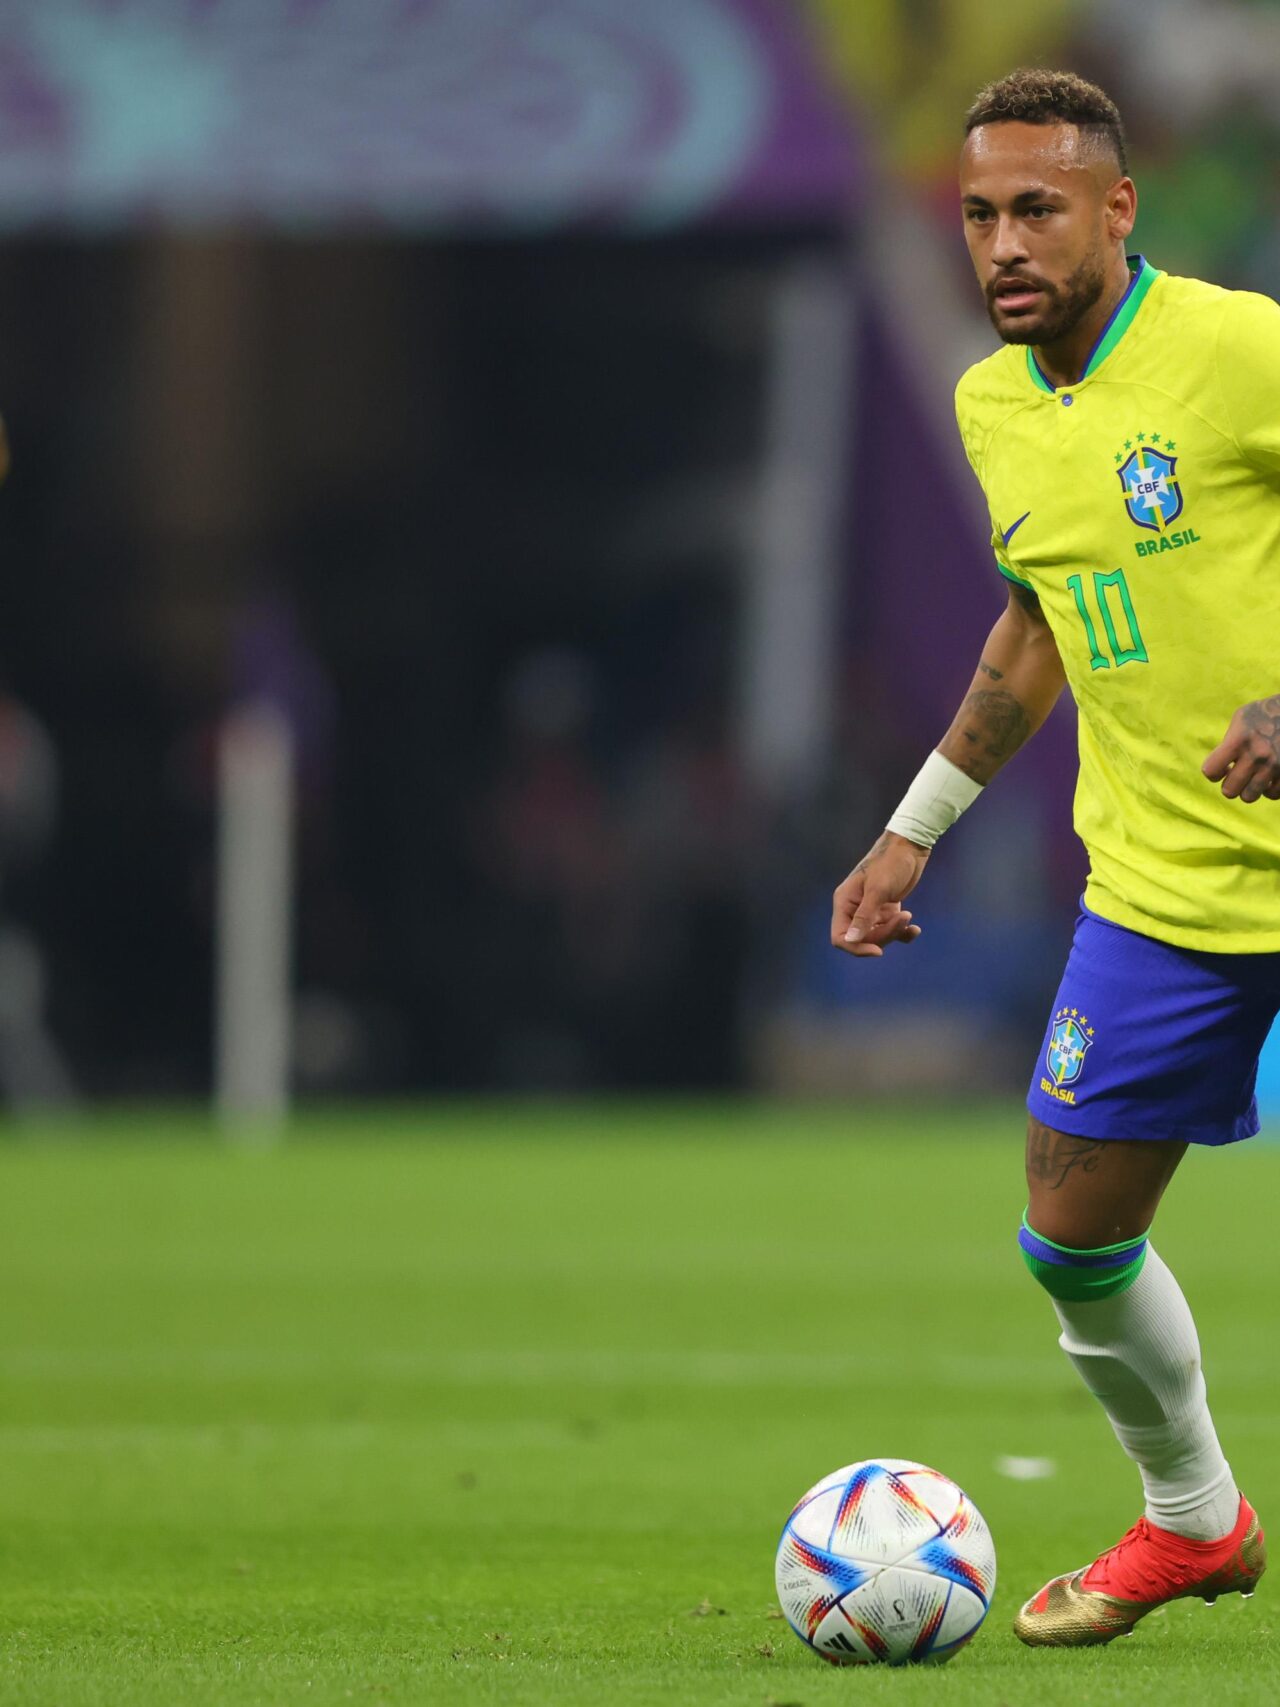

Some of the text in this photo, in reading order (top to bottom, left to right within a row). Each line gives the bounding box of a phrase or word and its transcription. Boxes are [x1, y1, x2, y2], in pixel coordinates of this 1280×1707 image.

[1137, 481, 1160, 494] CBF
[1135, 528, 1201, 557] BRASIL
[1066, 568, 1149, 671] 10
[1059, 1044, 1073, 1055] CBF
[1040, 1078, 1076, 1105] BRASIL
